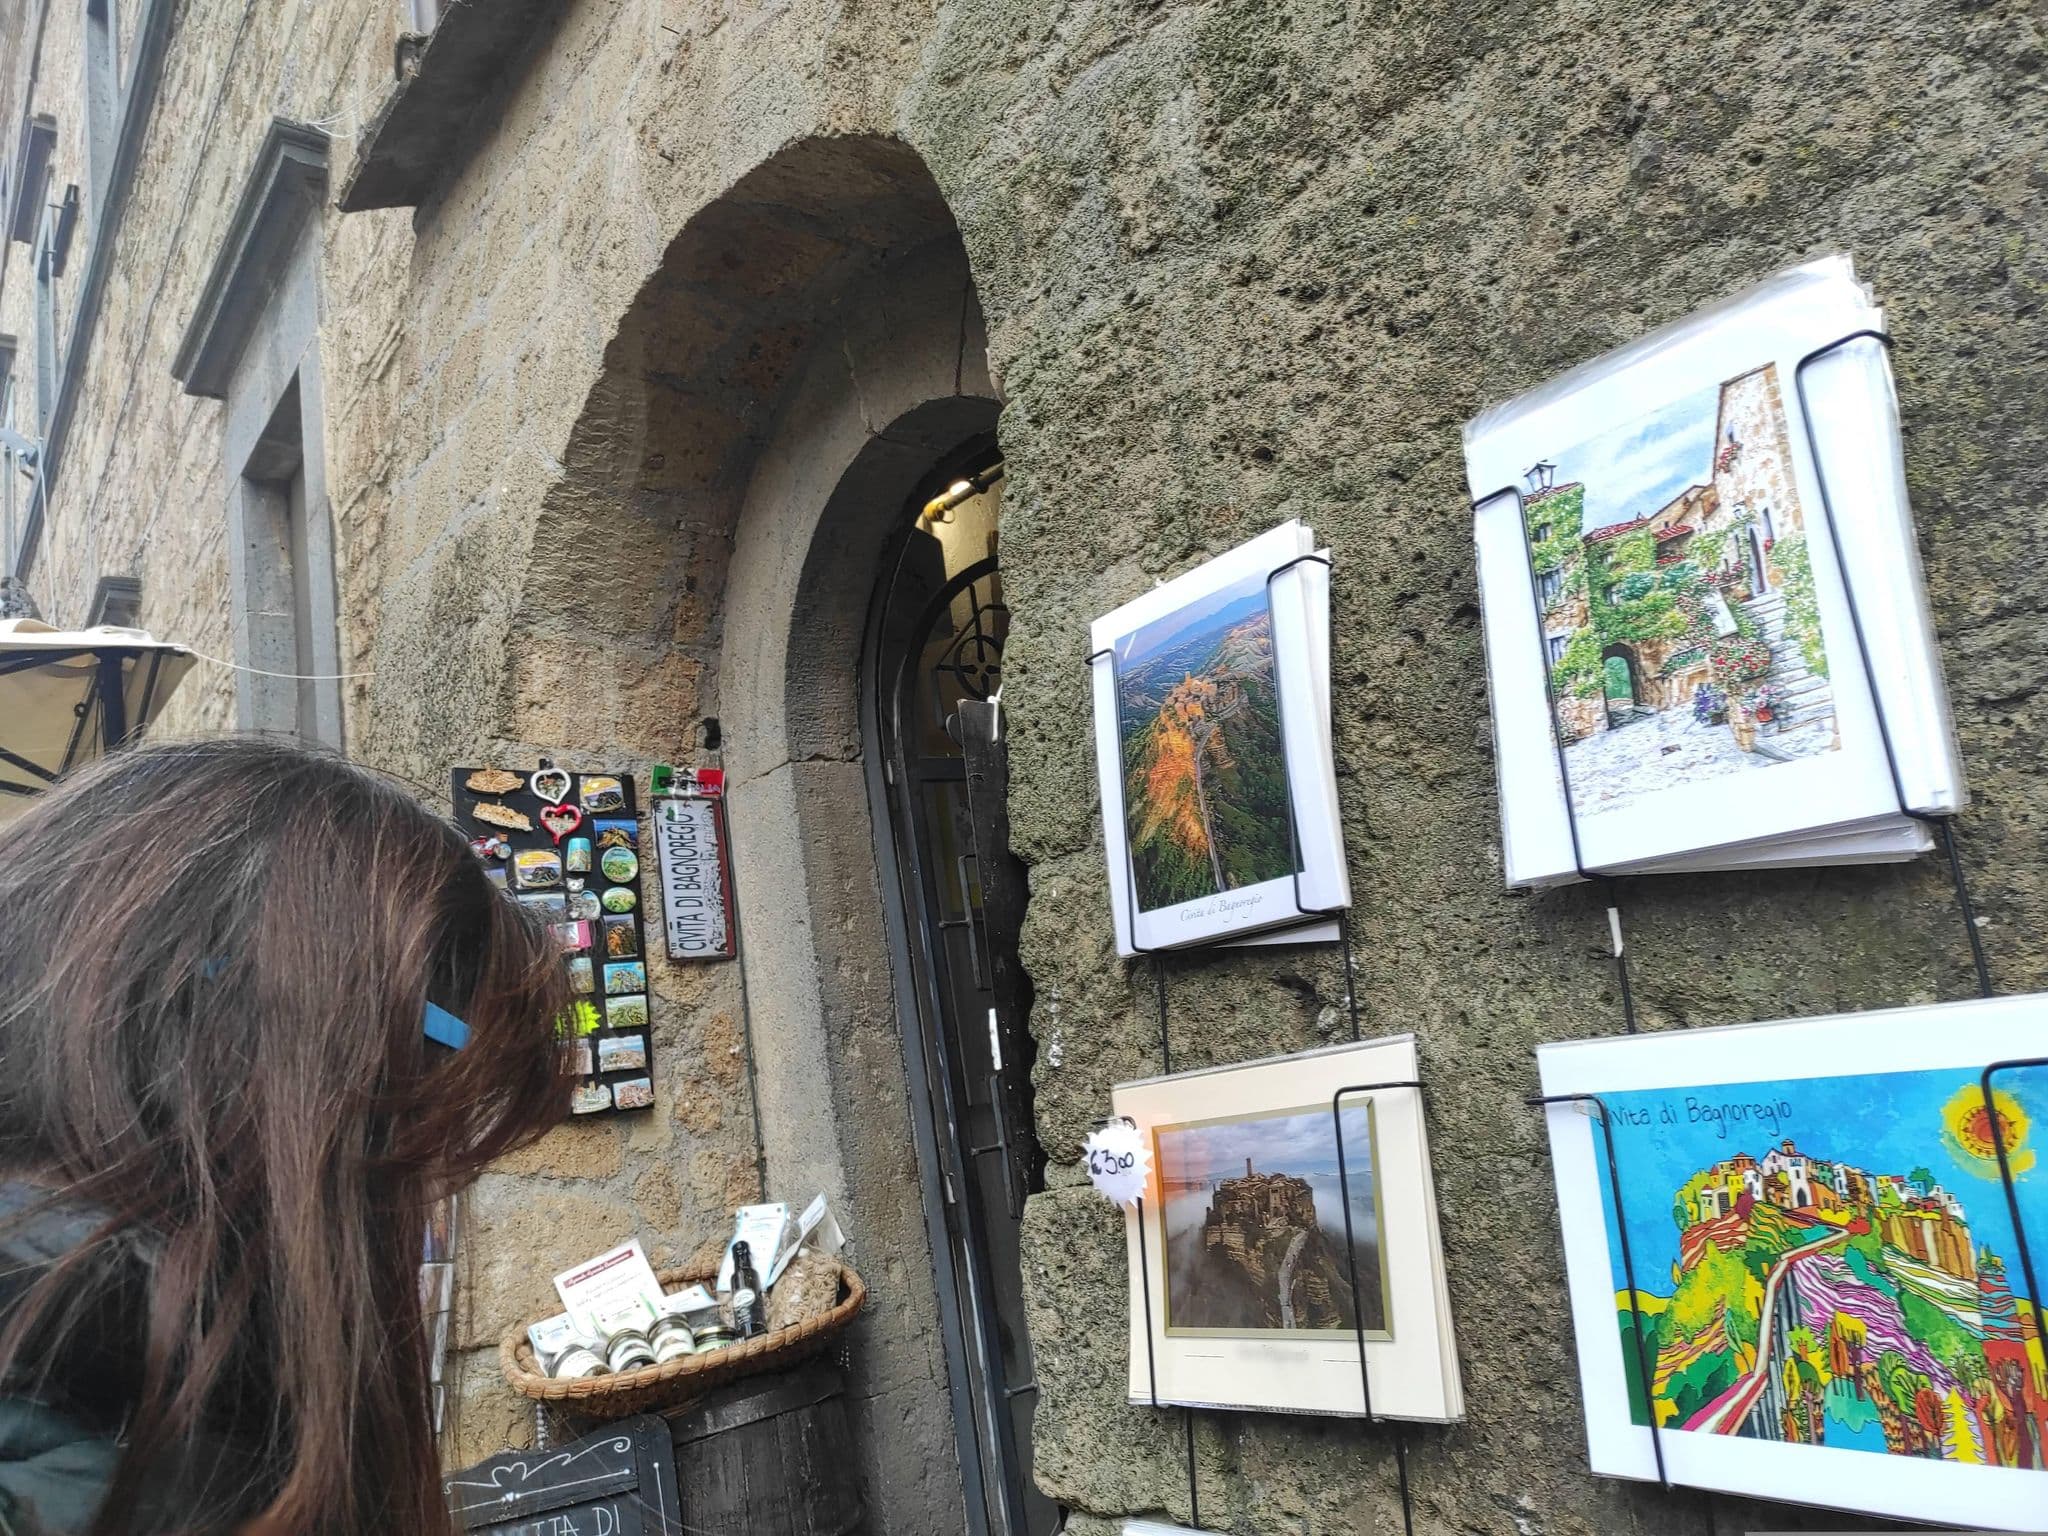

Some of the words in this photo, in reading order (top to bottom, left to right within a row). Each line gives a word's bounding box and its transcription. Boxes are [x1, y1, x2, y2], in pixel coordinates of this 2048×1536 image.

[664, 812, 702, 890] BAGNOREGIO
[676, 895, 704, 908] DI
[676, 912, 707, 951] CIVITA
[1596, 1106, 1651, 1128] ivita
[1661, 1100, 1679, 1125] di
[1685, 1096, 1792, 1139] Bagnoregio
[592, 1504, 621, 1536] DI
